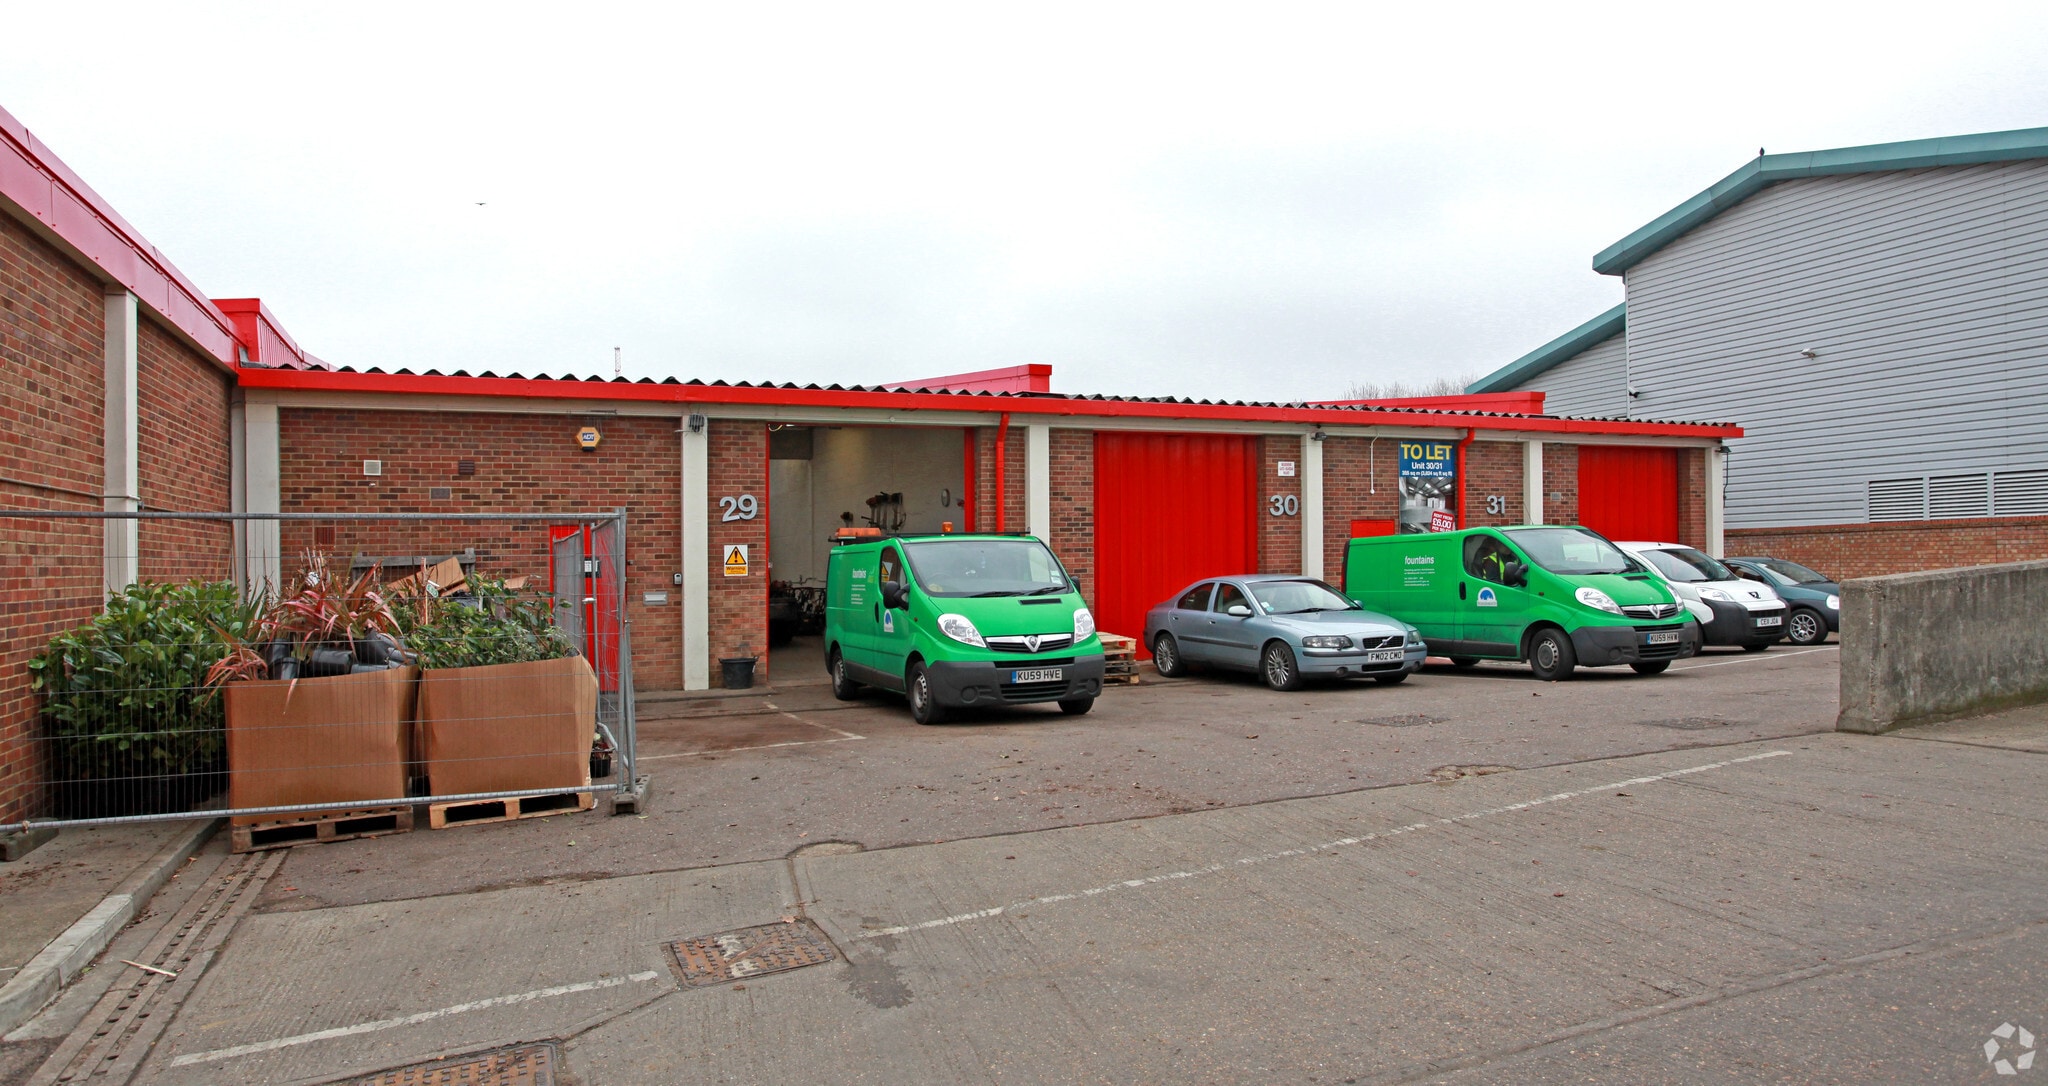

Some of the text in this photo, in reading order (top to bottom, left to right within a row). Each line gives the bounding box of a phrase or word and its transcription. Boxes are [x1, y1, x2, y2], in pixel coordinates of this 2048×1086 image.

[1401, 444, 1453, 460] TO LET
[1411, 462, 1443, 470] Unit 30/31
[719, 494, 758, 522] 29
[1269, 494, 1299, 516] 30
[1486, 495, 1506, 515] 31
[1432, 517, 1452, 529] £6.00
[1404, 554, 1435, 565] fountains
[1651, 634, 1666, 642] KU59
[1371, 652, 1388, 660] FM02
[1017, 669, 1061, 680] KU59 HVE
